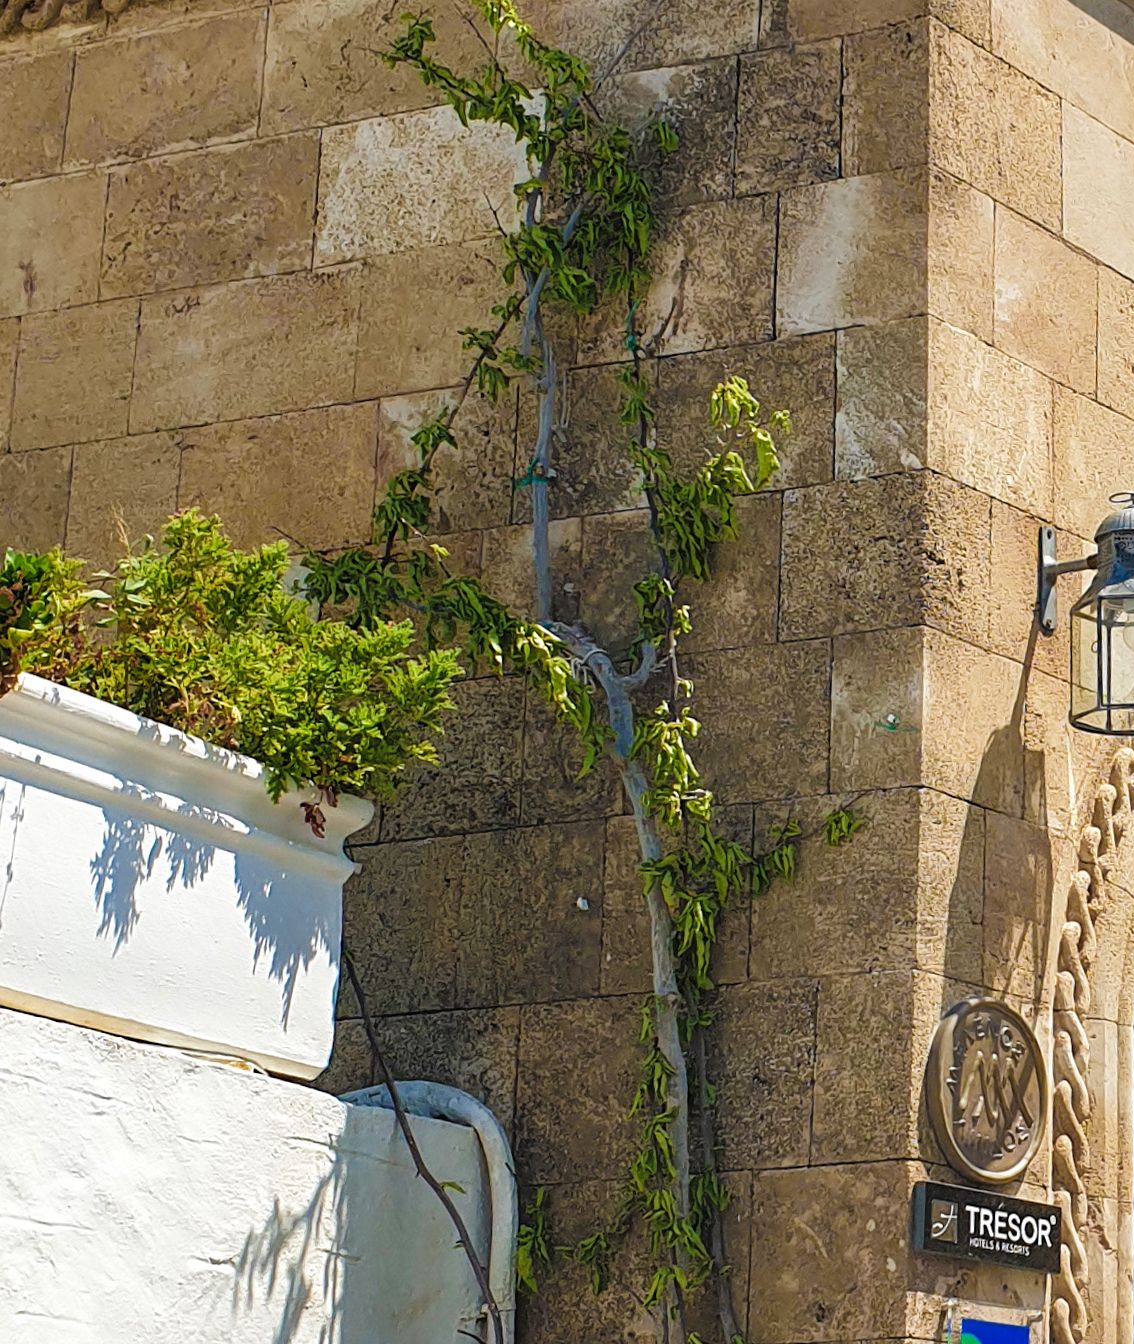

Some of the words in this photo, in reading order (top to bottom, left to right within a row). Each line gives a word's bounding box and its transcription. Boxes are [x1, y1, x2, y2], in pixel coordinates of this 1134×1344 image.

[969, 1237, 995, 1251] HOTELS
[995, 1241, 1001, 1251] &
[1001, 1242, 1030, 1256] RESORTS
